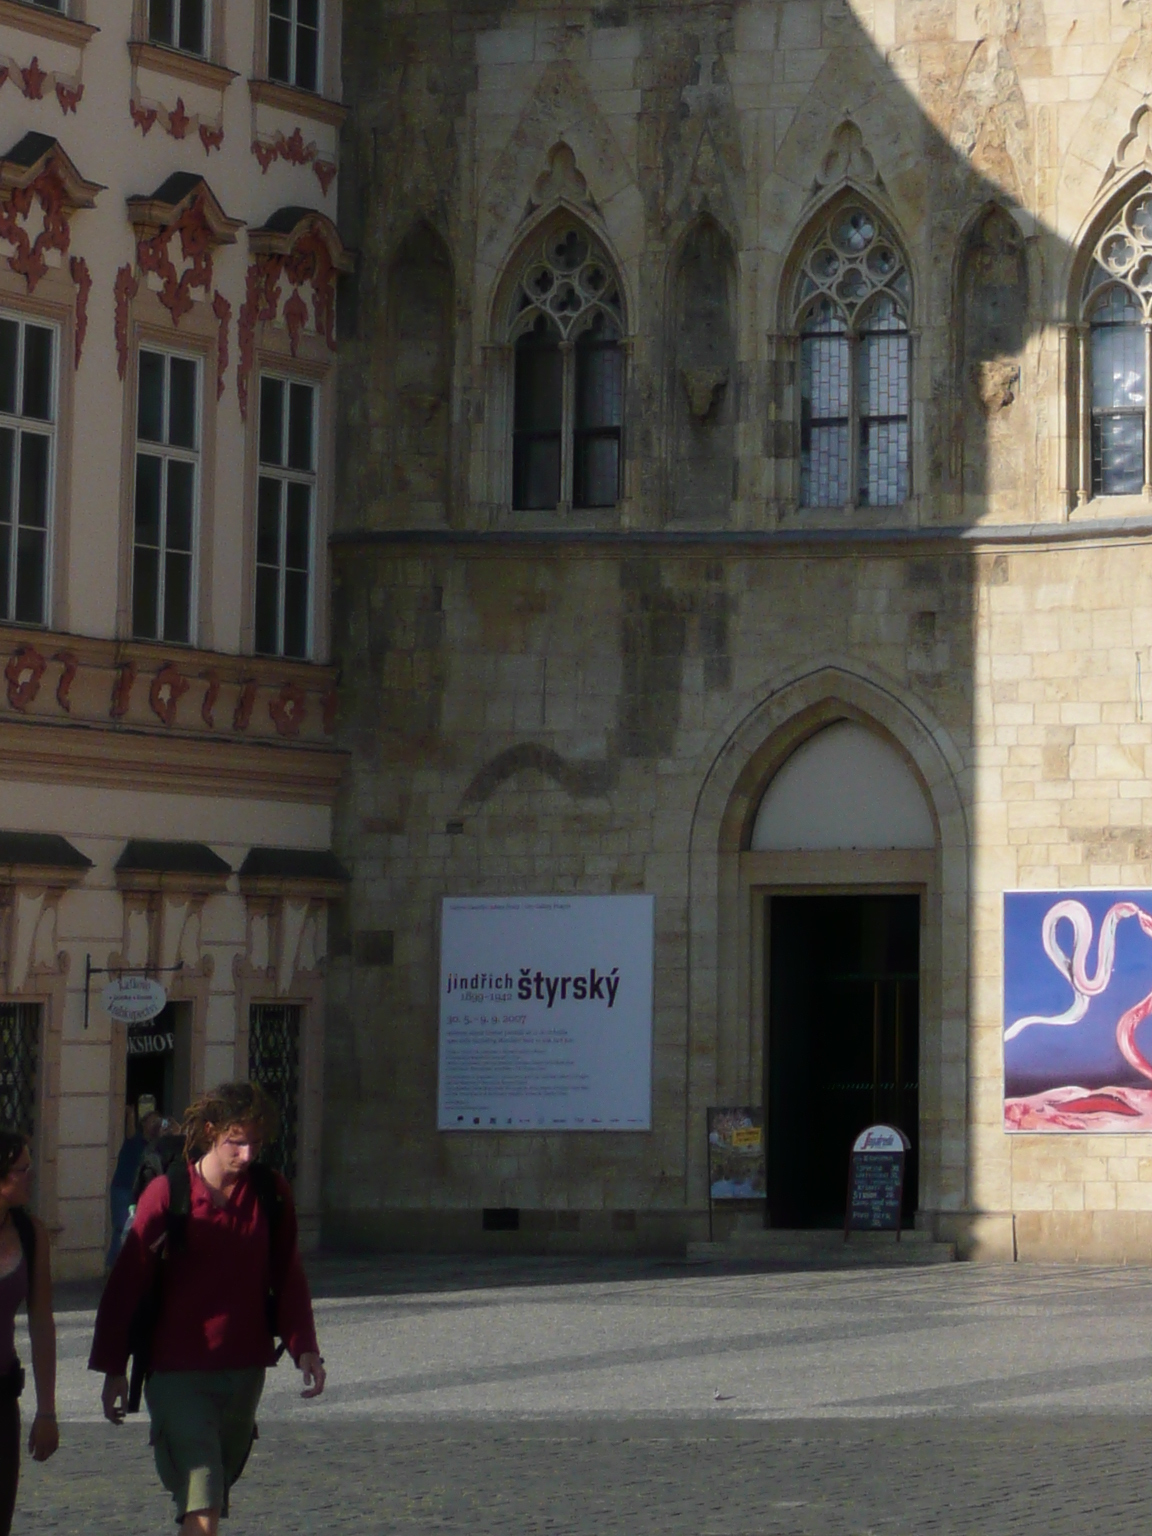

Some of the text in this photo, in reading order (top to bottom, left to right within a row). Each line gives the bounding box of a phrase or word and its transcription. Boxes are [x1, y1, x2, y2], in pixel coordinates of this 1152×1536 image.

[447, 968, 620, 1007] jindřich štyrský
[502, 1015, 527, 1024] 2007
[127, 1032, 174, 1053] KSHOP
